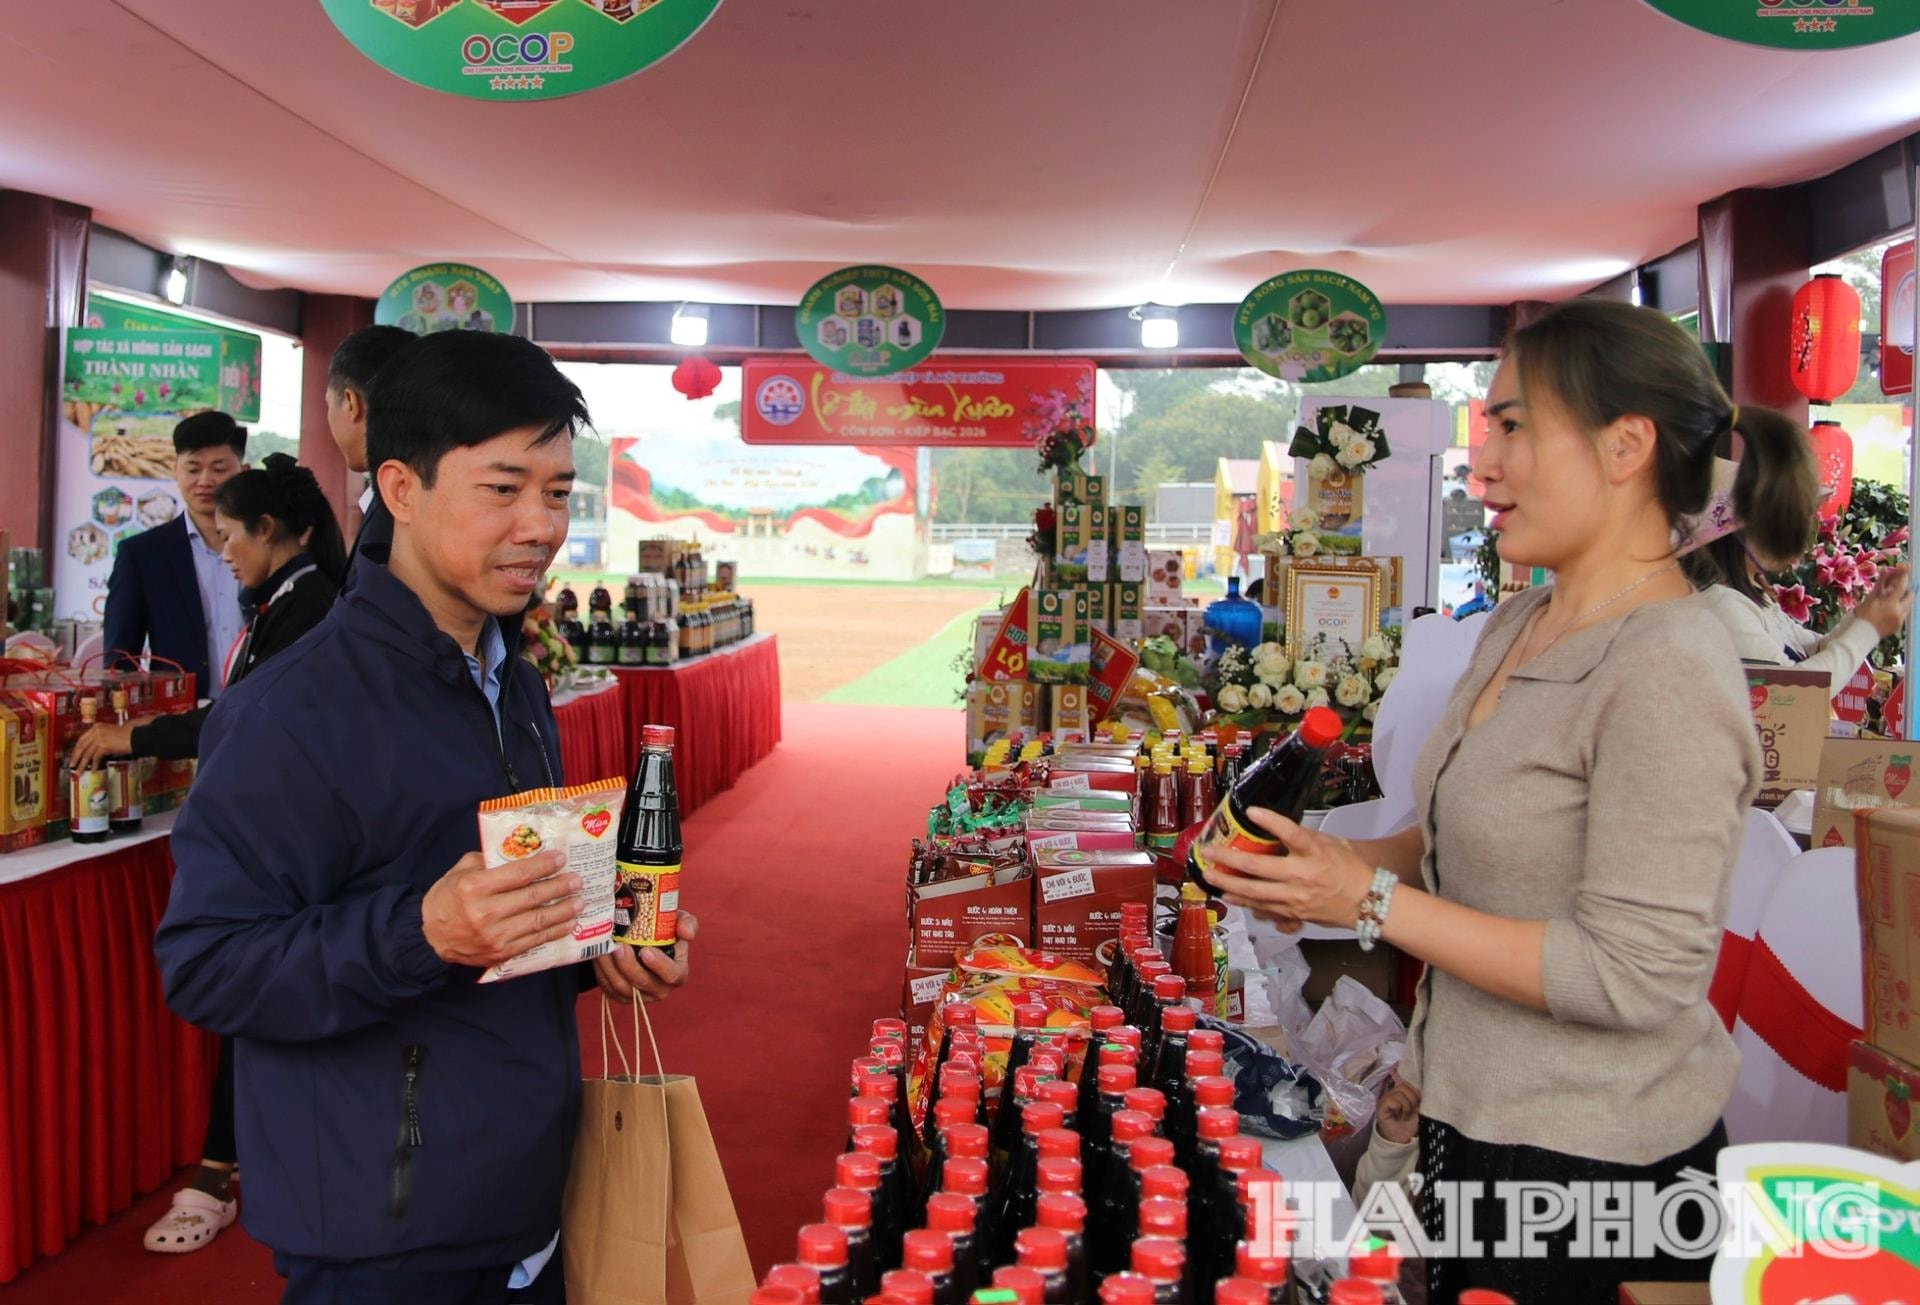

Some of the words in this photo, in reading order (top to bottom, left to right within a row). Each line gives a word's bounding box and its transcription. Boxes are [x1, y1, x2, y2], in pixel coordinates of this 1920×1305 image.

[462, 32, 574, 65] OCOP
[84, 358, 145, 377] THÀNH
[584, 816, 608, 829] Misa
[1110, 911, 1122, 920] HOÀ
